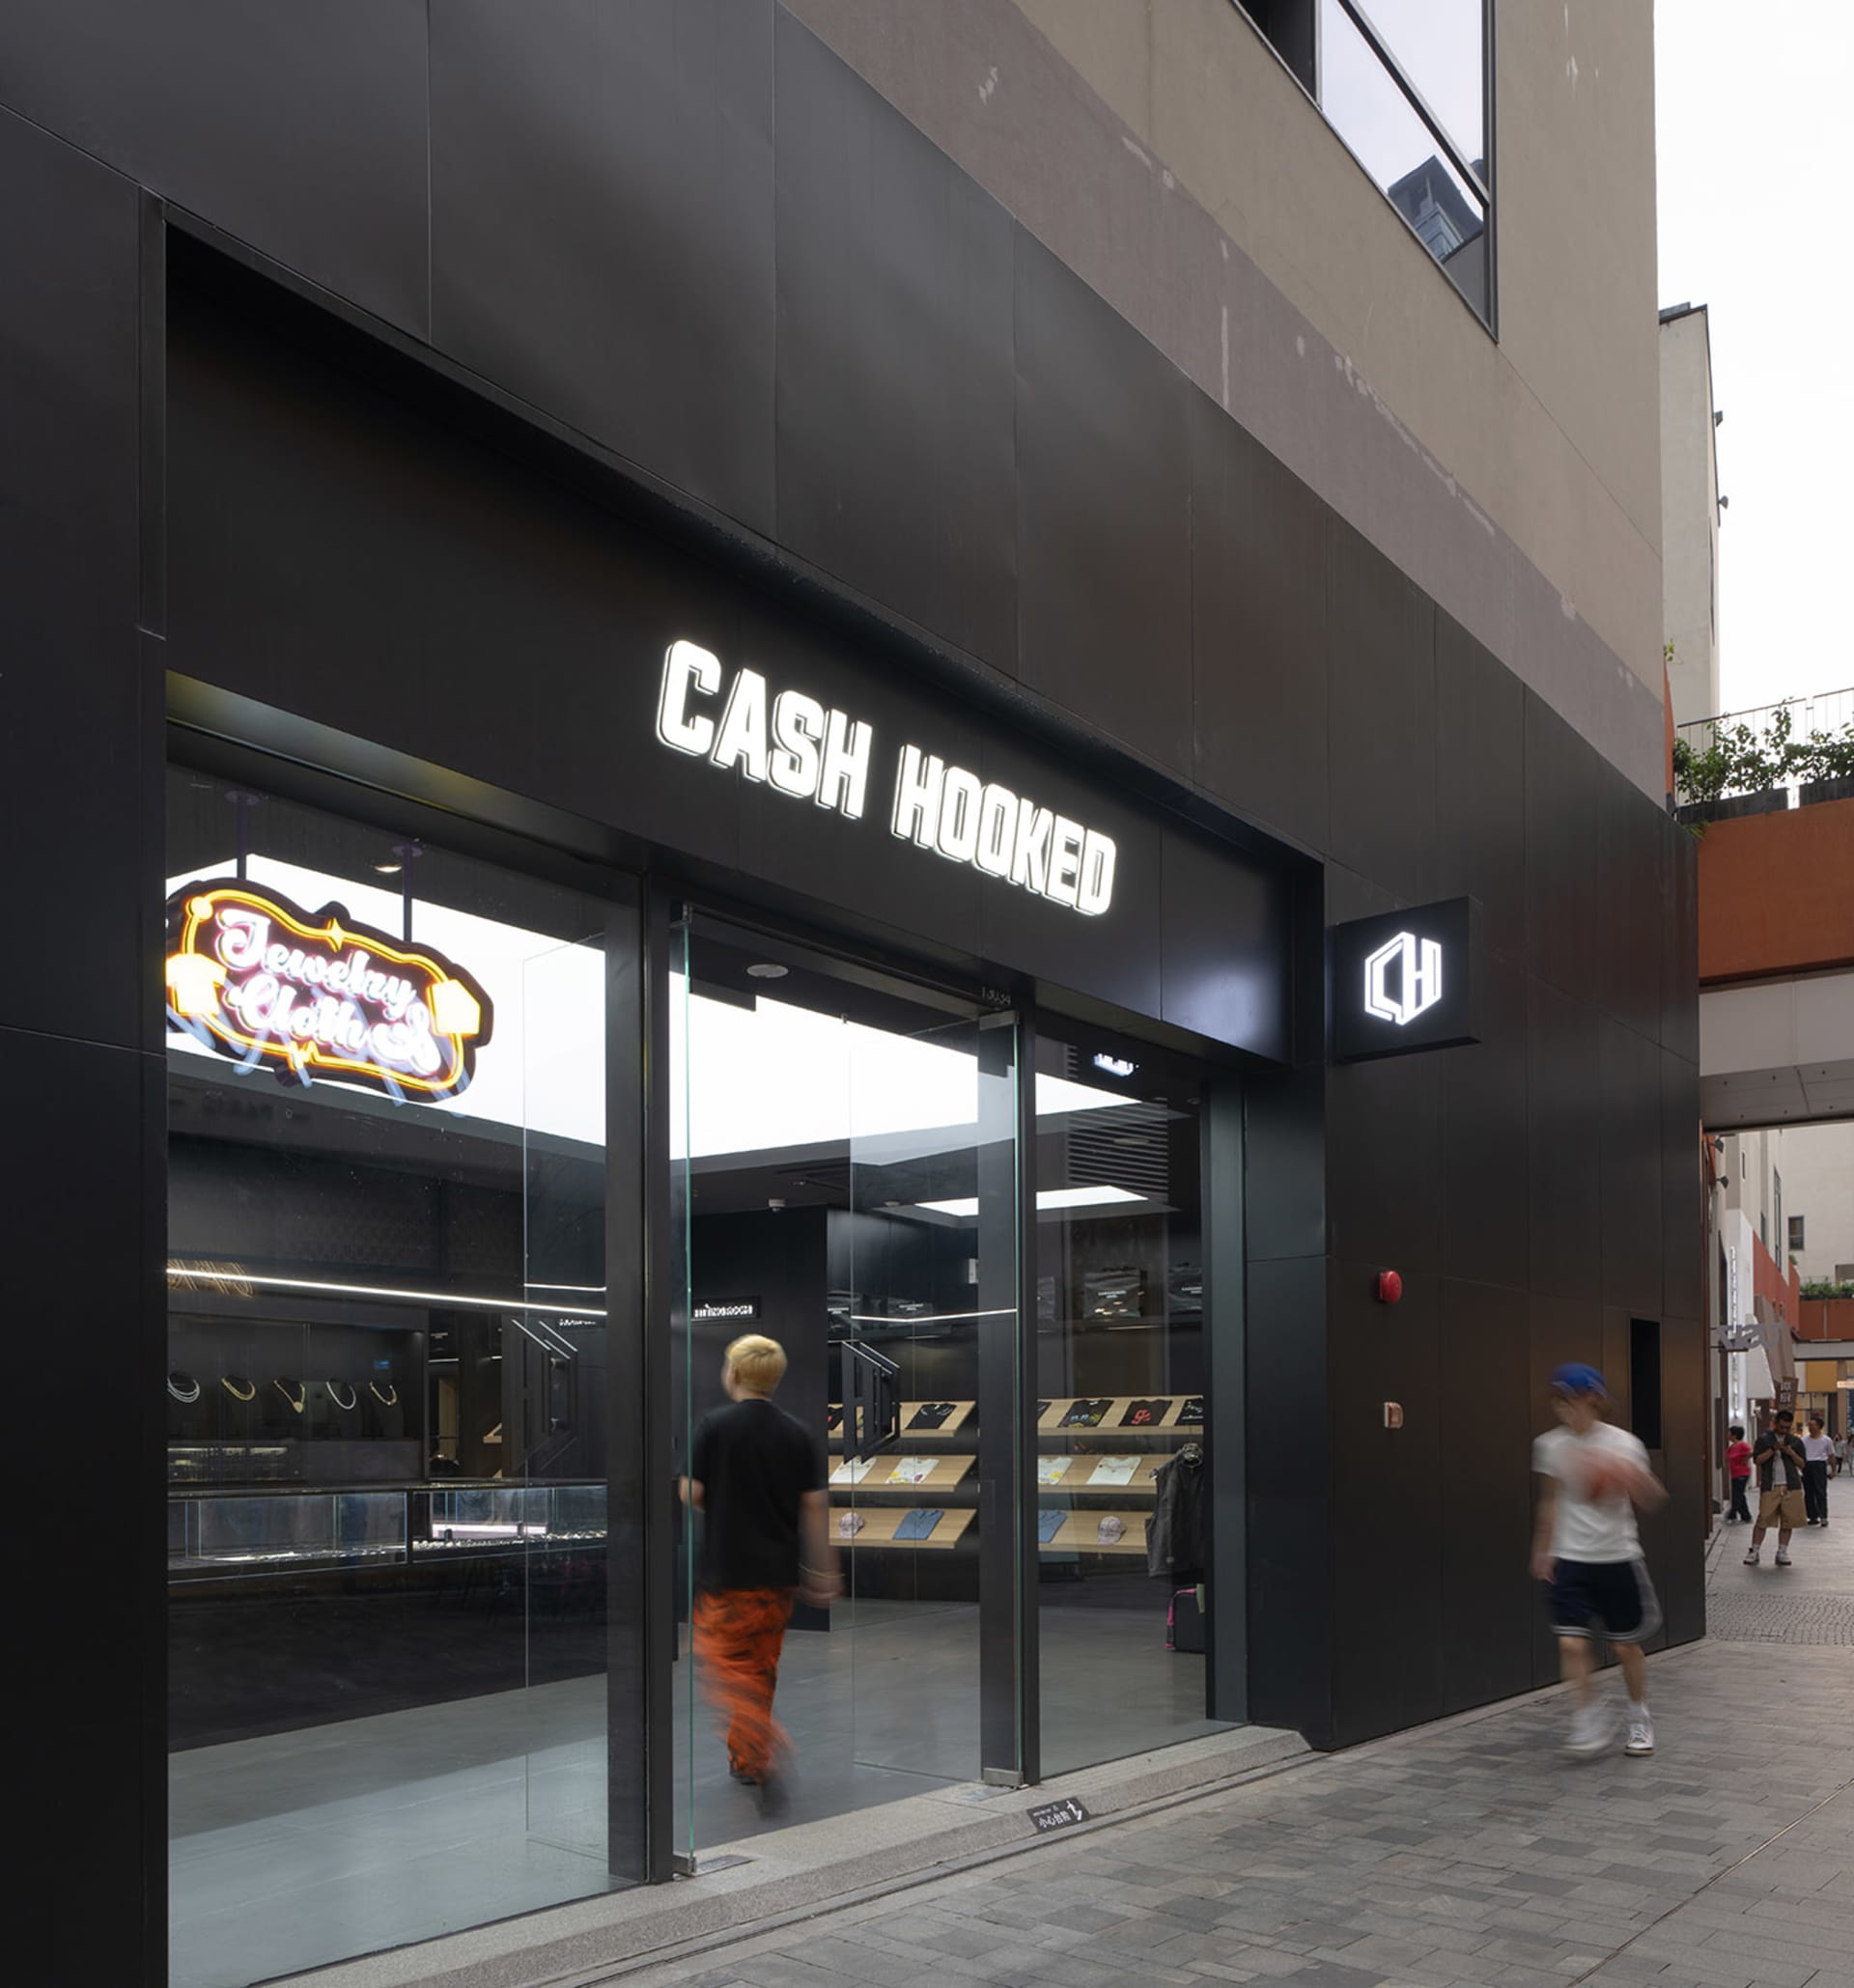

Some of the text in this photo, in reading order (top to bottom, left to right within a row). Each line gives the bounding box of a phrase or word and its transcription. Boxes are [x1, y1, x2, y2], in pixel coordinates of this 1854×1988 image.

[656, 639, 1116, 916] CASH HOOKED
[215, 909, 416, 1021] Jewelry
